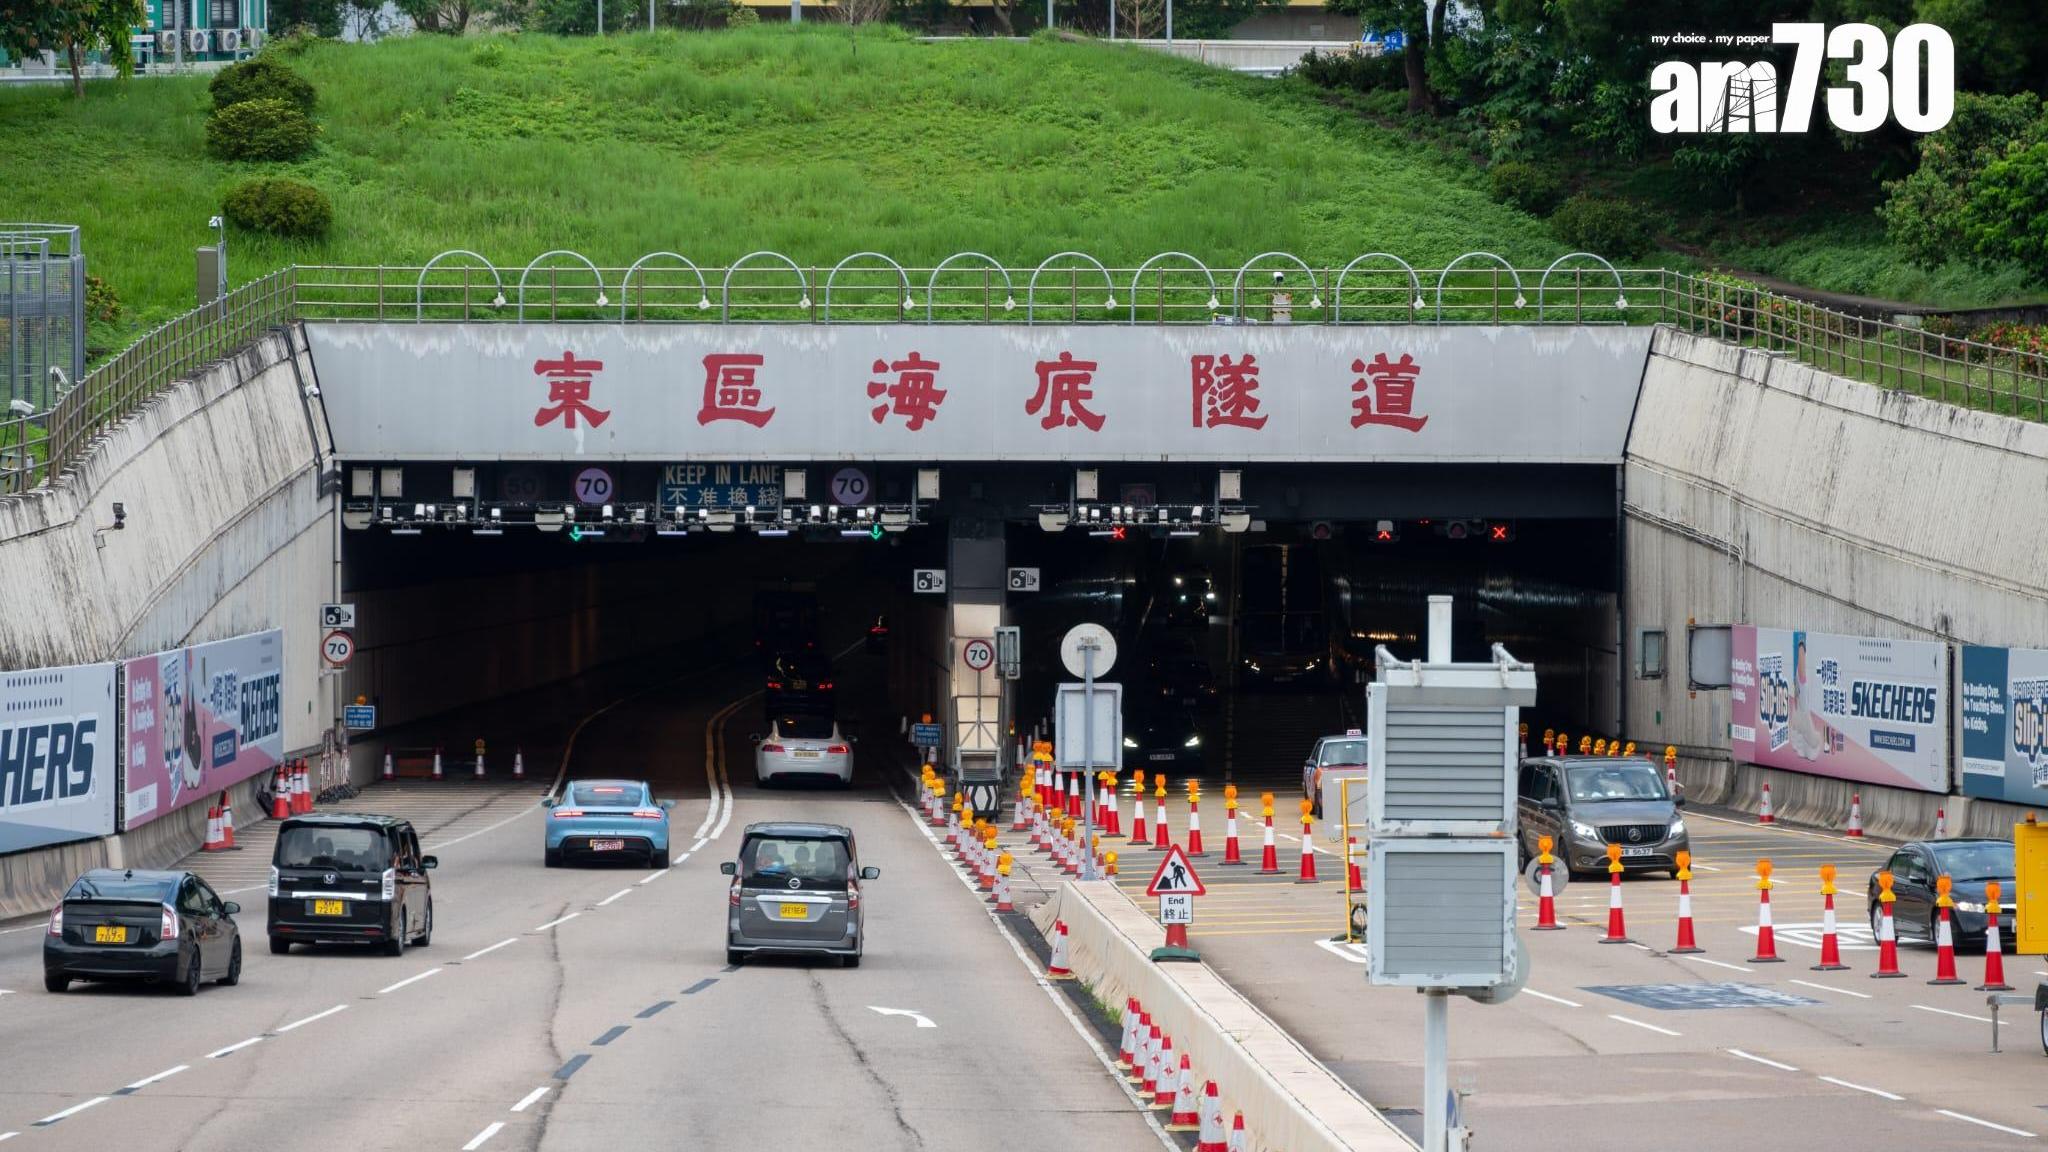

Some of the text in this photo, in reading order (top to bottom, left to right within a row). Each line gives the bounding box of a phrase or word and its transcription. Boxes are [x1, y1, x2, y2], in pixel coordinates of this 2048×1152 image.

[533, 351, 1429, 433] 東區海底隧道
[665, 464, 780, 485] KEEP IN LANE
[580, 478, 608, 496] 70
[836, 478, 864, 496] 70
[328, 643, 348, 655] 70
[969, 648, 988, 662] 70
[240, 673, 280, 746] SKECHERS
[1851, 681, 1937, 724] SKECHERS
[0, 719, 97, 808] HERS
[1168, 897, 1184, 905] End
[1164, 908, 1189, 920] 終止
